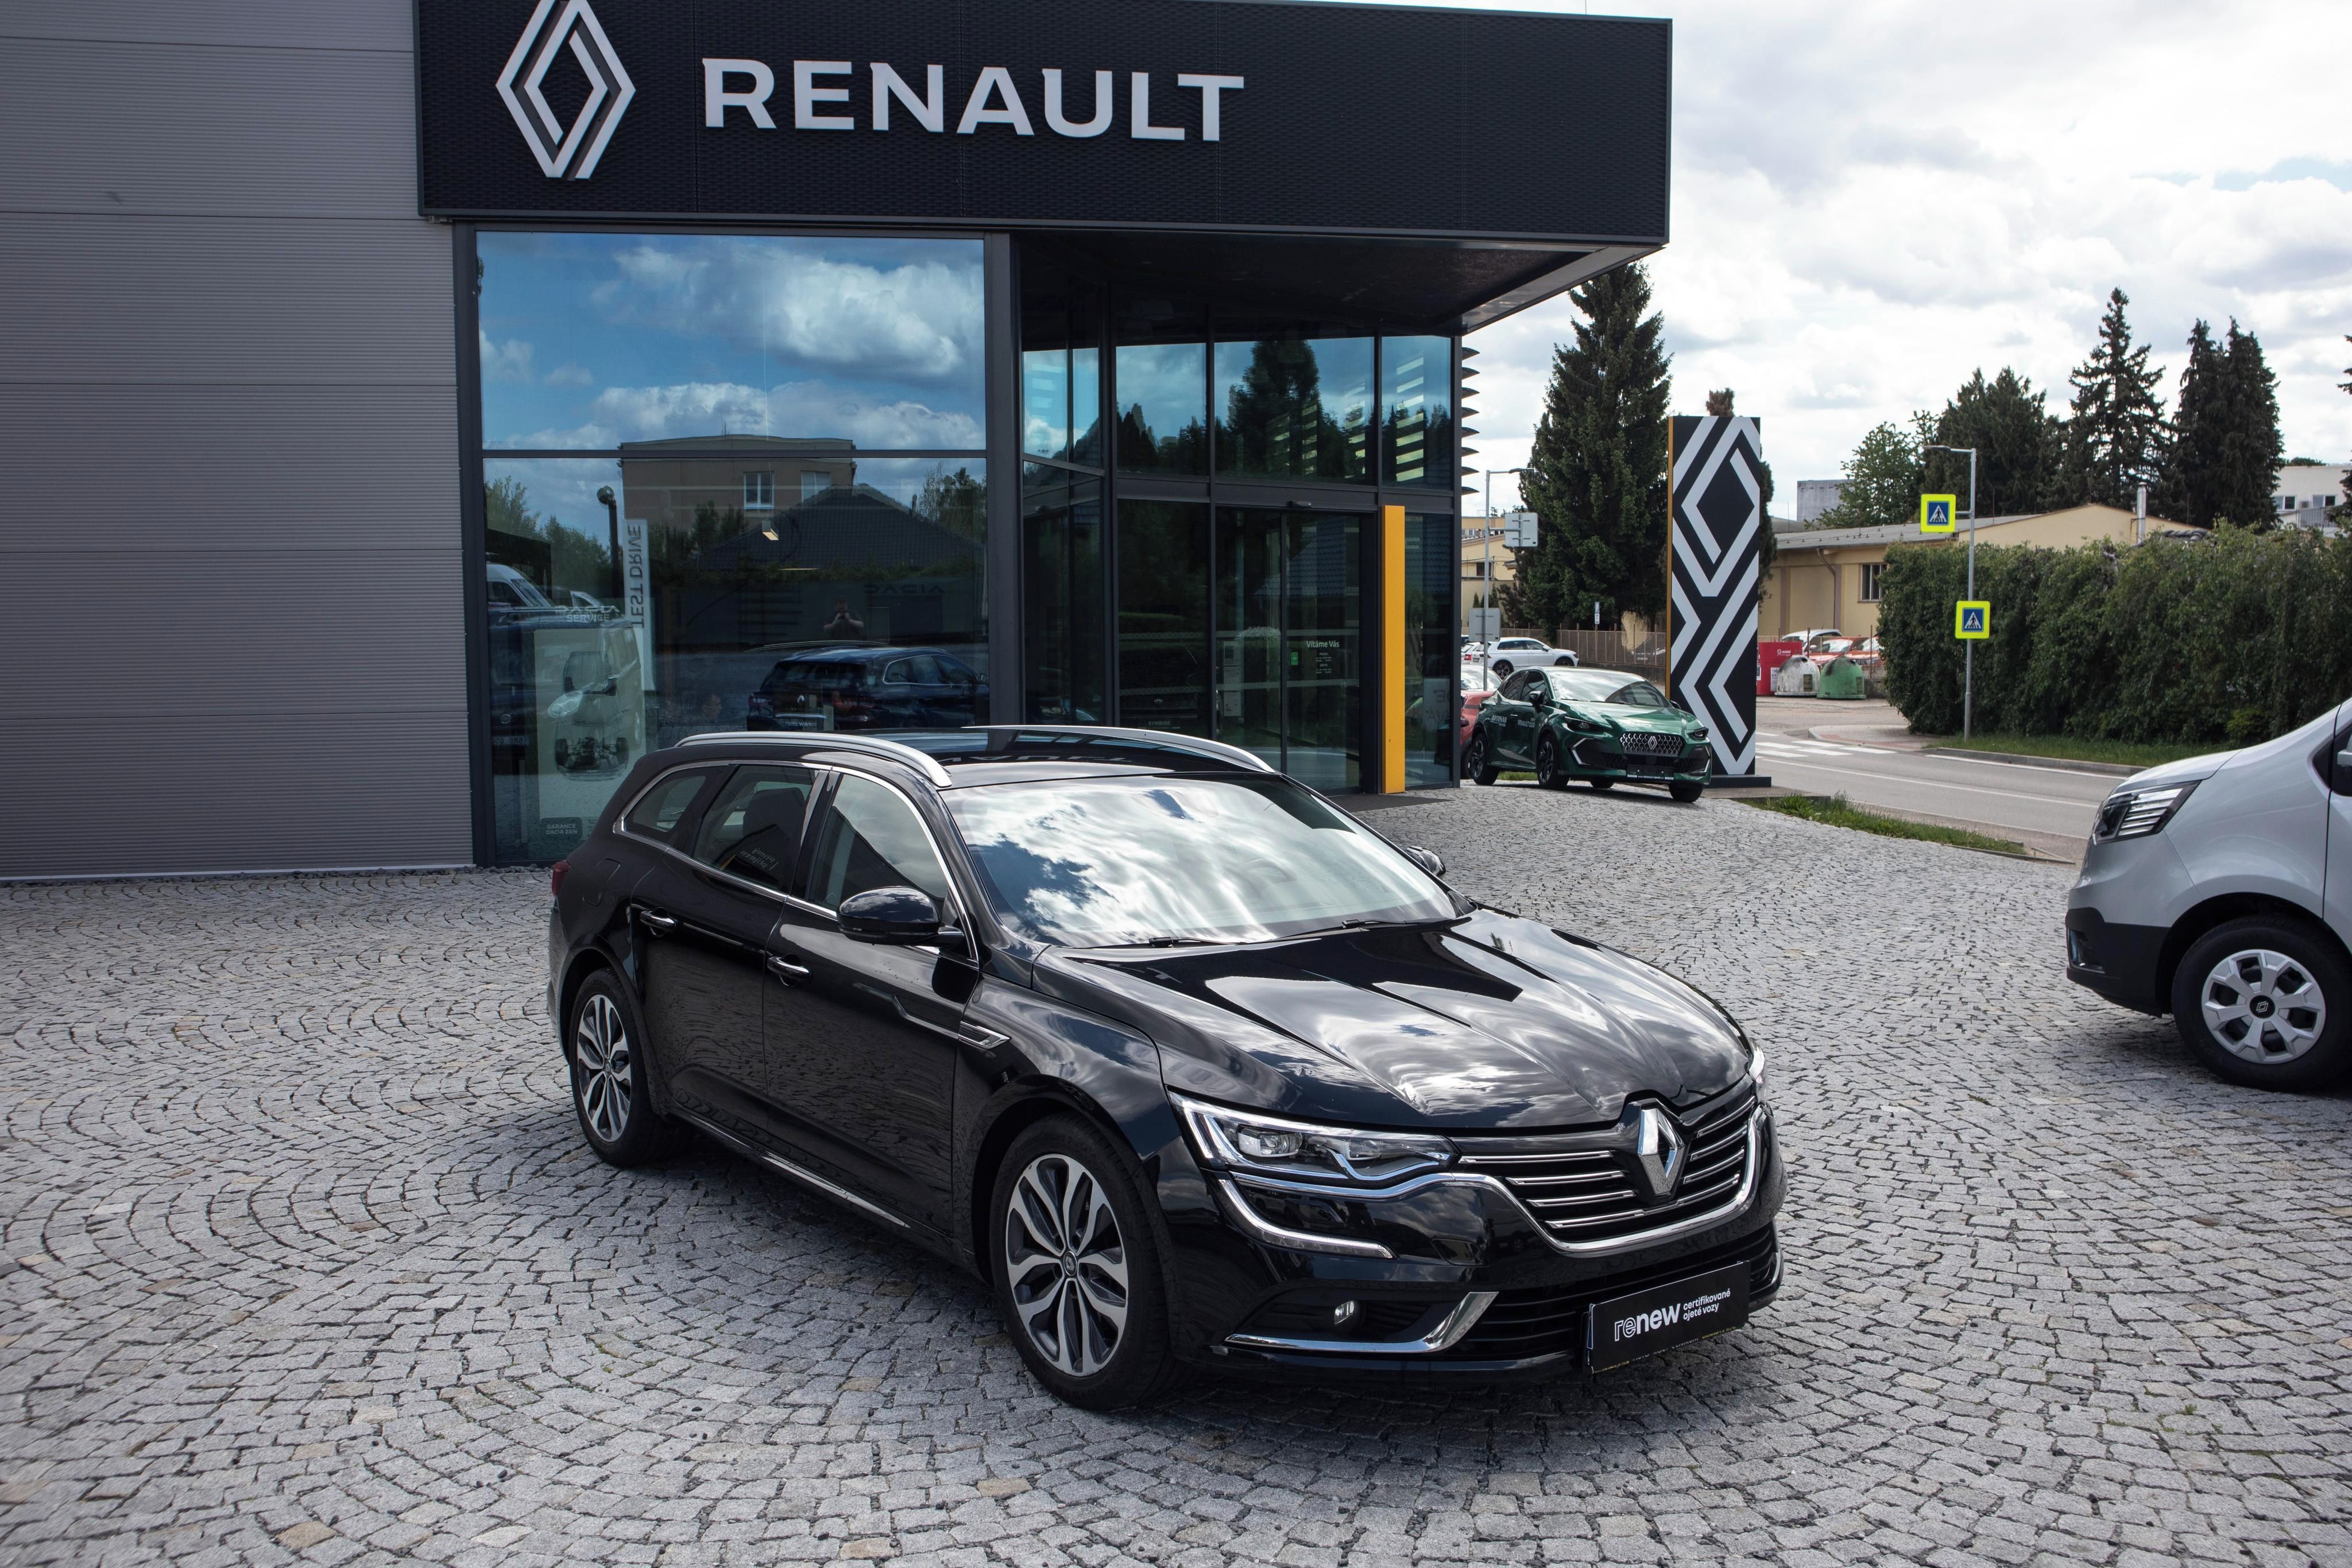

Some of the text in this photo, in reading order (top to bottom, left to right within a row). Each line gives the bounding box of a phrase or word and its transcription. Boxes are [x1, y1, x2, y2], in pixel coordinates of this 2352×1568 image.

[702, 57, 1244, 142] RENAULT
[864, 584, 946, 594] DACIA
[567, 614, 610, 623] SERVICE
[1306, 640, 1340, 648] Vítáme Vás
[1683, 1288, 1731, 1310] certifikované
[1683, 1302, 1719, 1322] ojeté vozy
[1614, 1303, 1681, 1342] renew
